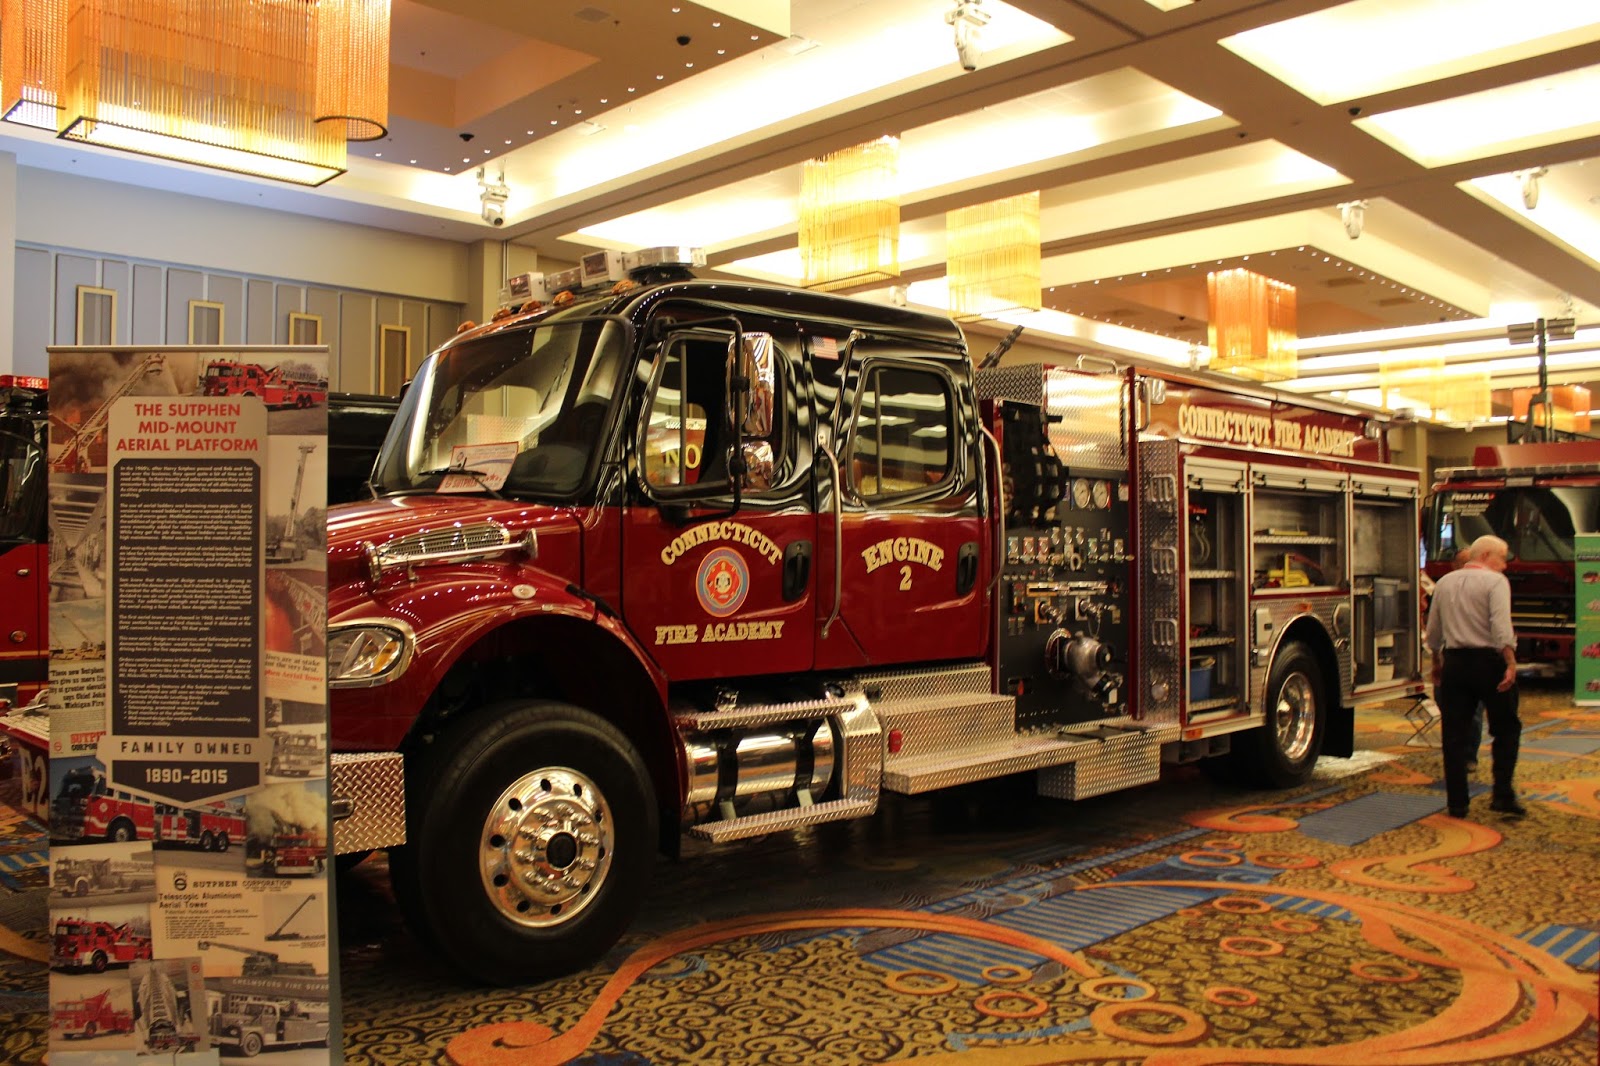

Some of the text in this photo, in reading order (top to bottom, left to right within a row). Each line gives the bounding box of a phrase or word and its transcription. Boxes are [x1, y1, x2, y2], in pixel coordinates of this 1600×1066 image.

[135, 403, 240, 416] THE SUTPHEN
[139, 421, 236, 433] MID-MOUNT
[1178, 403, 1355, 457] CONNECTICUT FIRE ACADEMY
[116, 438, 258, 451] AERIAL PLATFORM
[661, 521, 783, 566] CONNECTICUT
[861, 537, 944, 573] ENGINE
[899, 566, 913, 591] 2
[654, 621, 785, 645] FIRE ACADEMY
[121, 741, 252, 755] FAMILY OWNED
[146, 768, 228, 784] 1890-2015
[159, 893, 198, 902] Telescopic
